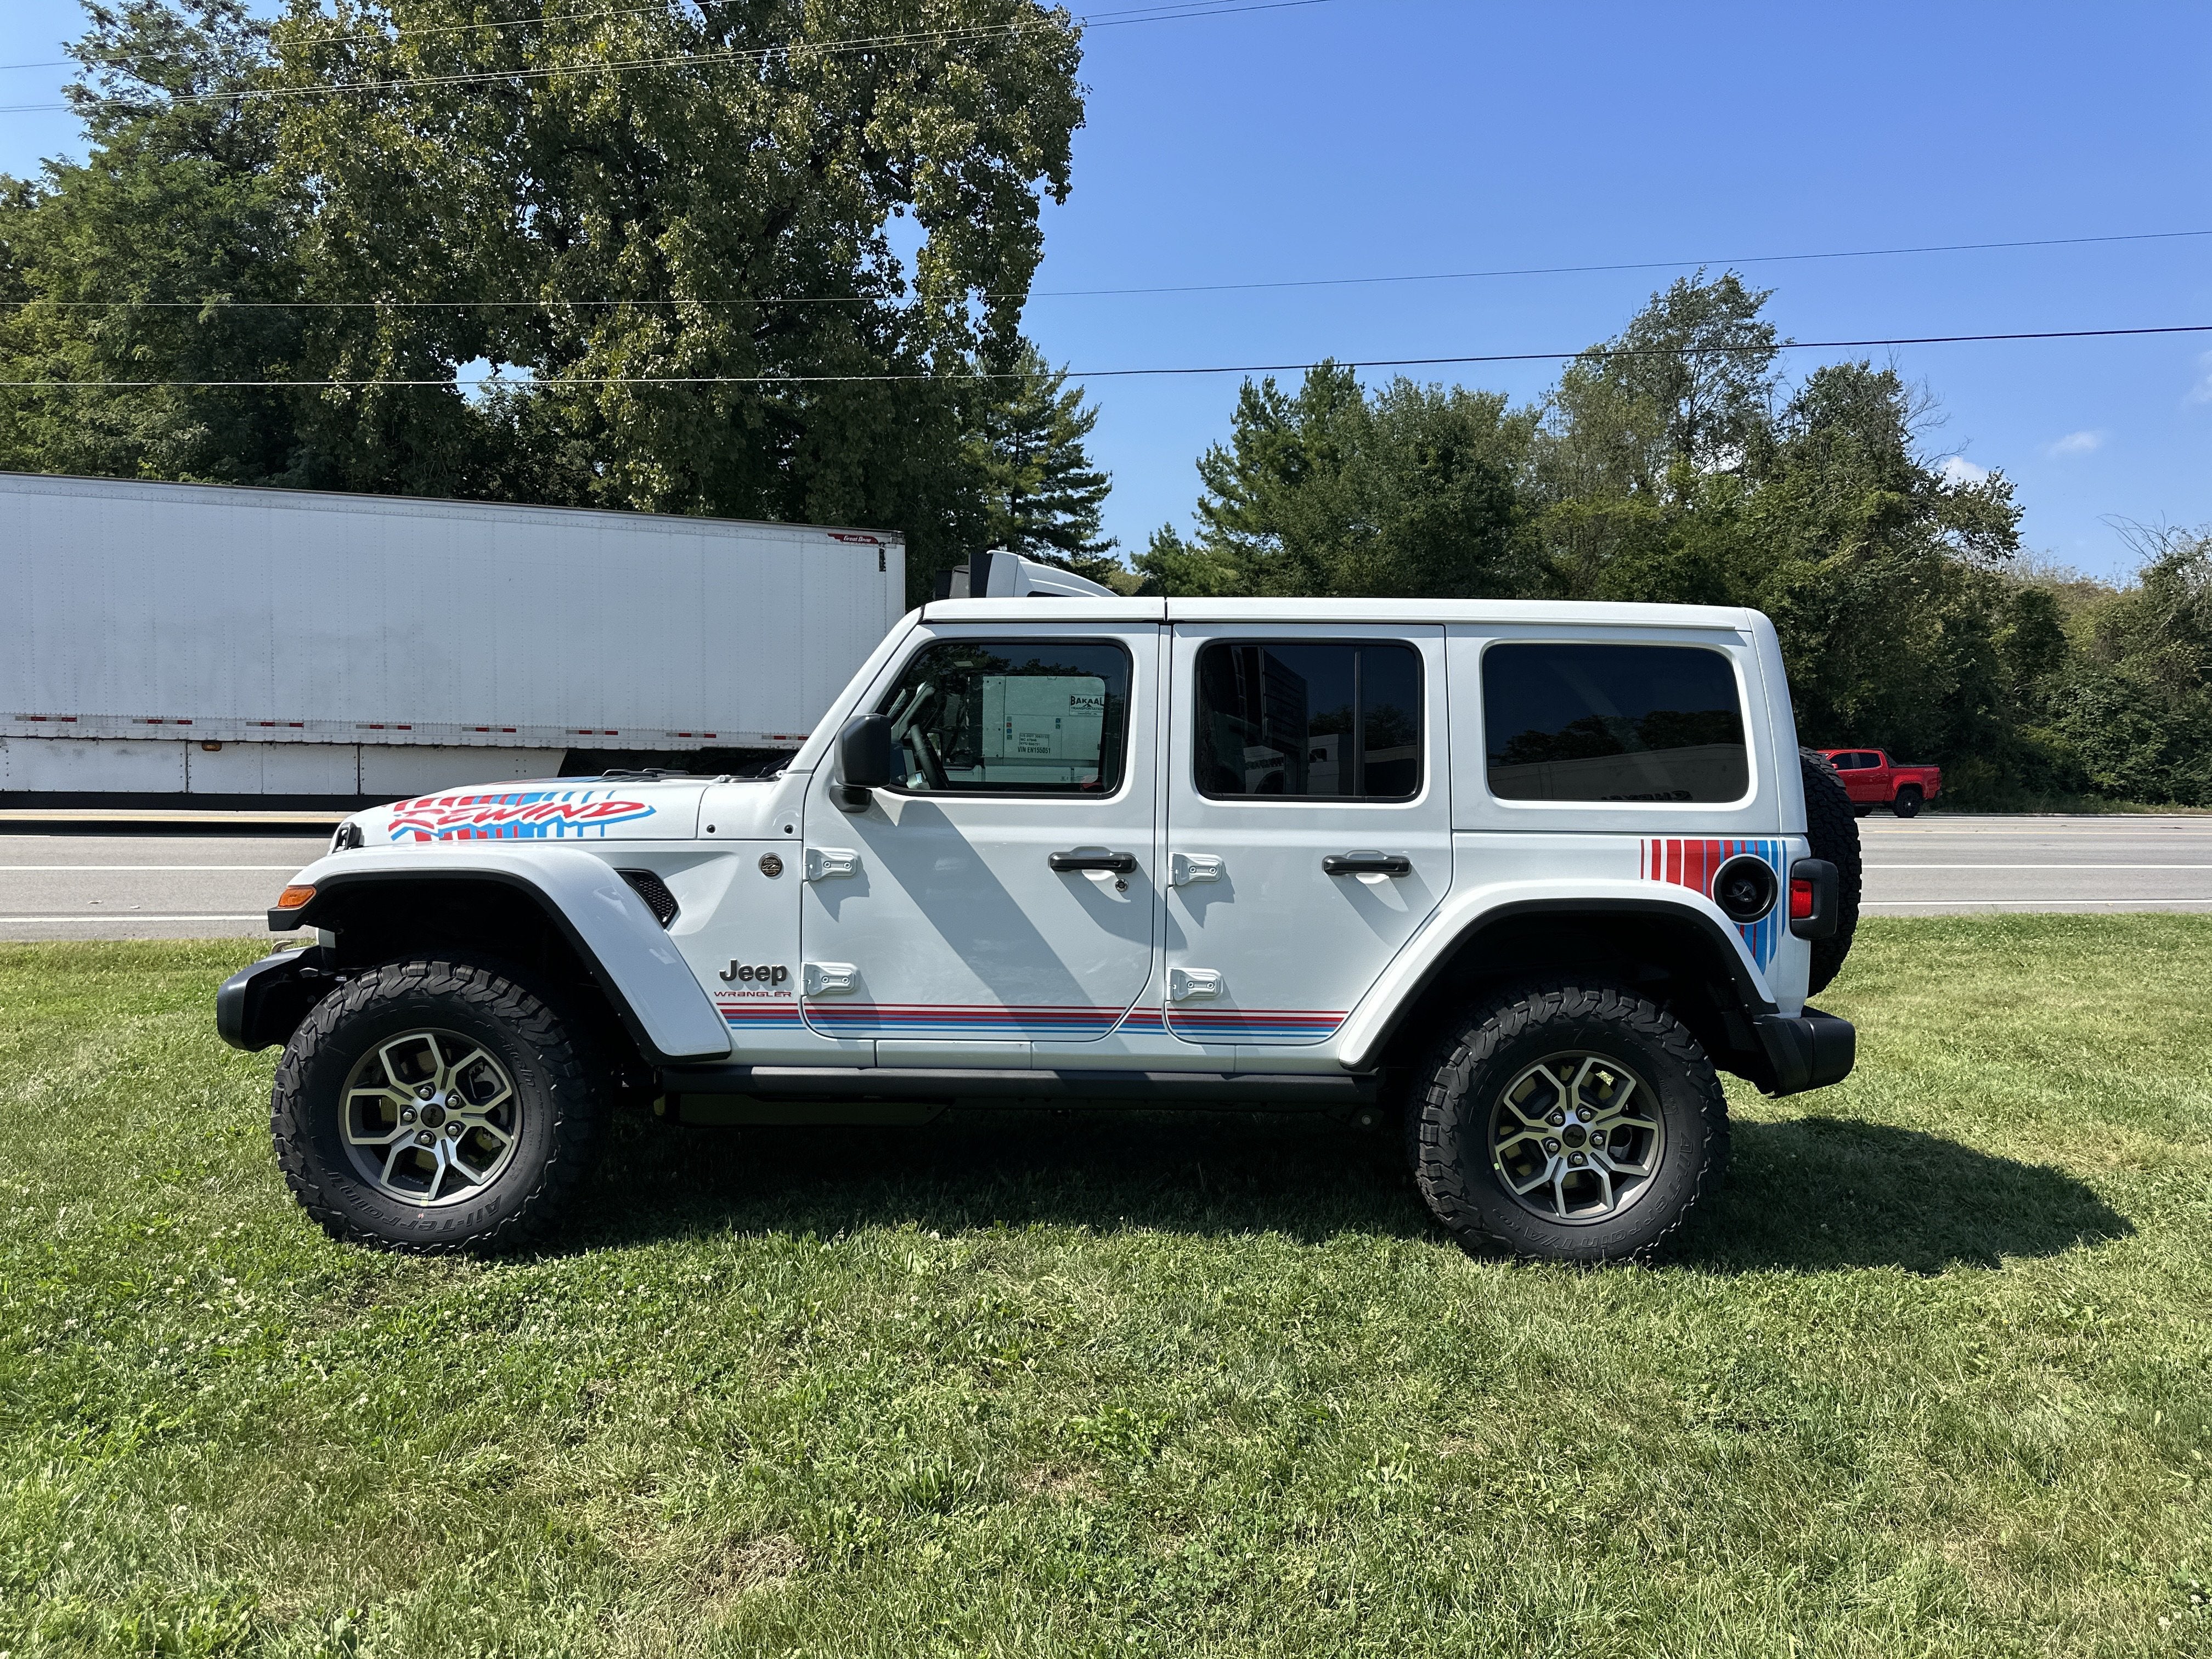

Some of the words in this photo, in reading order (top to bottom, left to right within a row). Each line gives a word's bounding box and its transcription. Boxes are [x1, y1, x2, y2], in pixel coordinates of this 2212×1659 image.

[1070, 695, 1104, 706] BAKAAL
[387, 800, 646, 833] REWIND
[719, 958, 787, 986] Jeep
